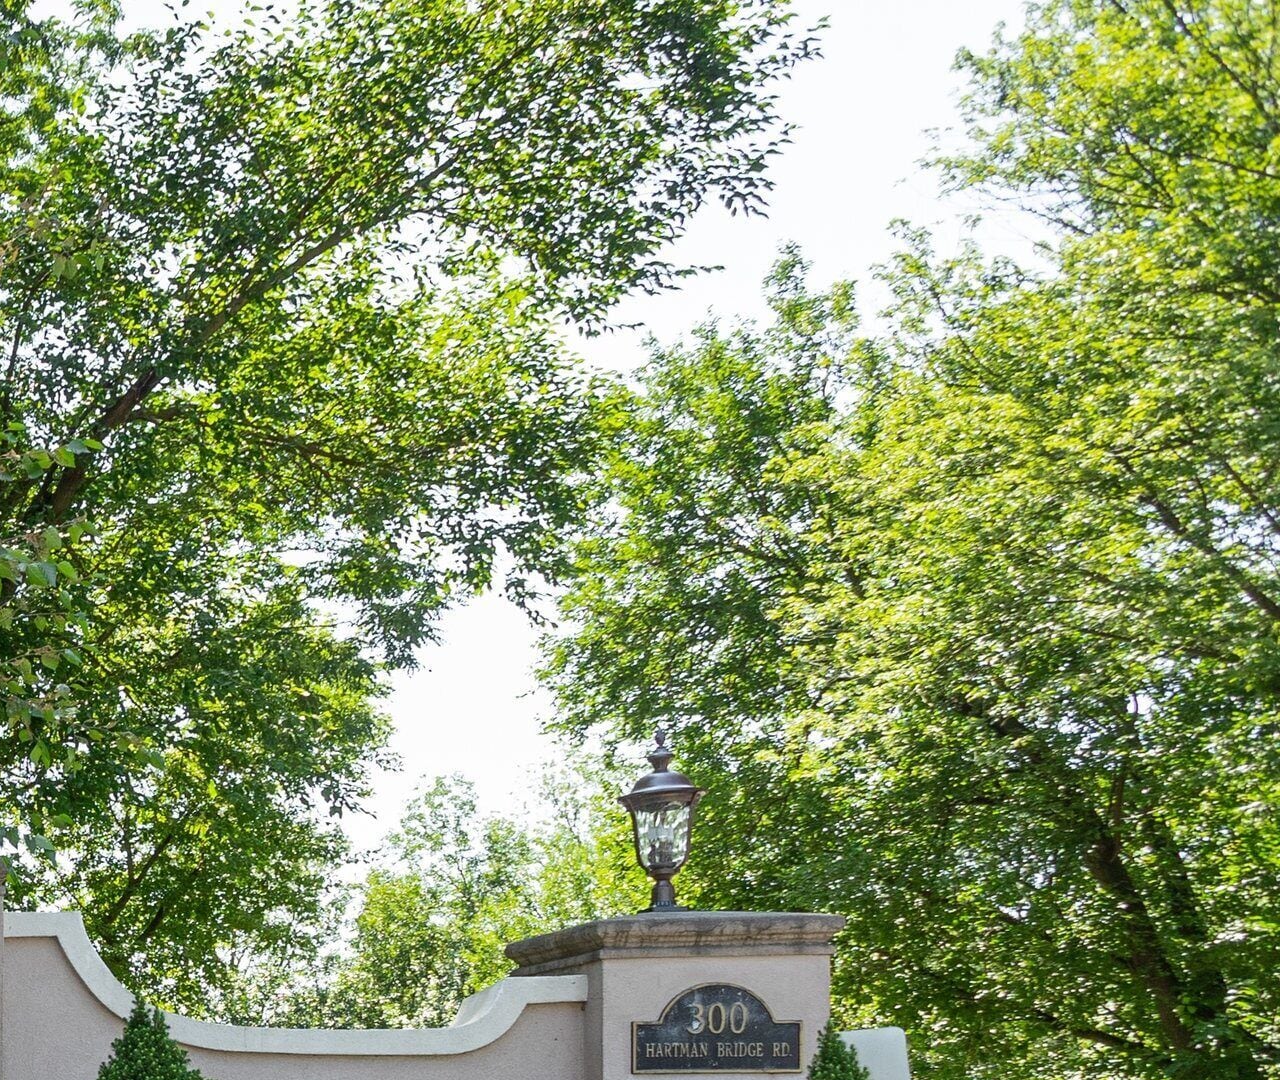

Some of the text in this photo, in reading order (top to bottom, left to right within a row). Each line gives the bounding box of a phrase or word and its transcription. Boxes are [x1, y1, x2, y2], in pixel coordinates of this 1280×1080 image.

[686, 1001, 749, 1035] 300
[646, 1042, 708, 1059] HARTMAN
[717, 1042, 763, 1058] BRIDGE
